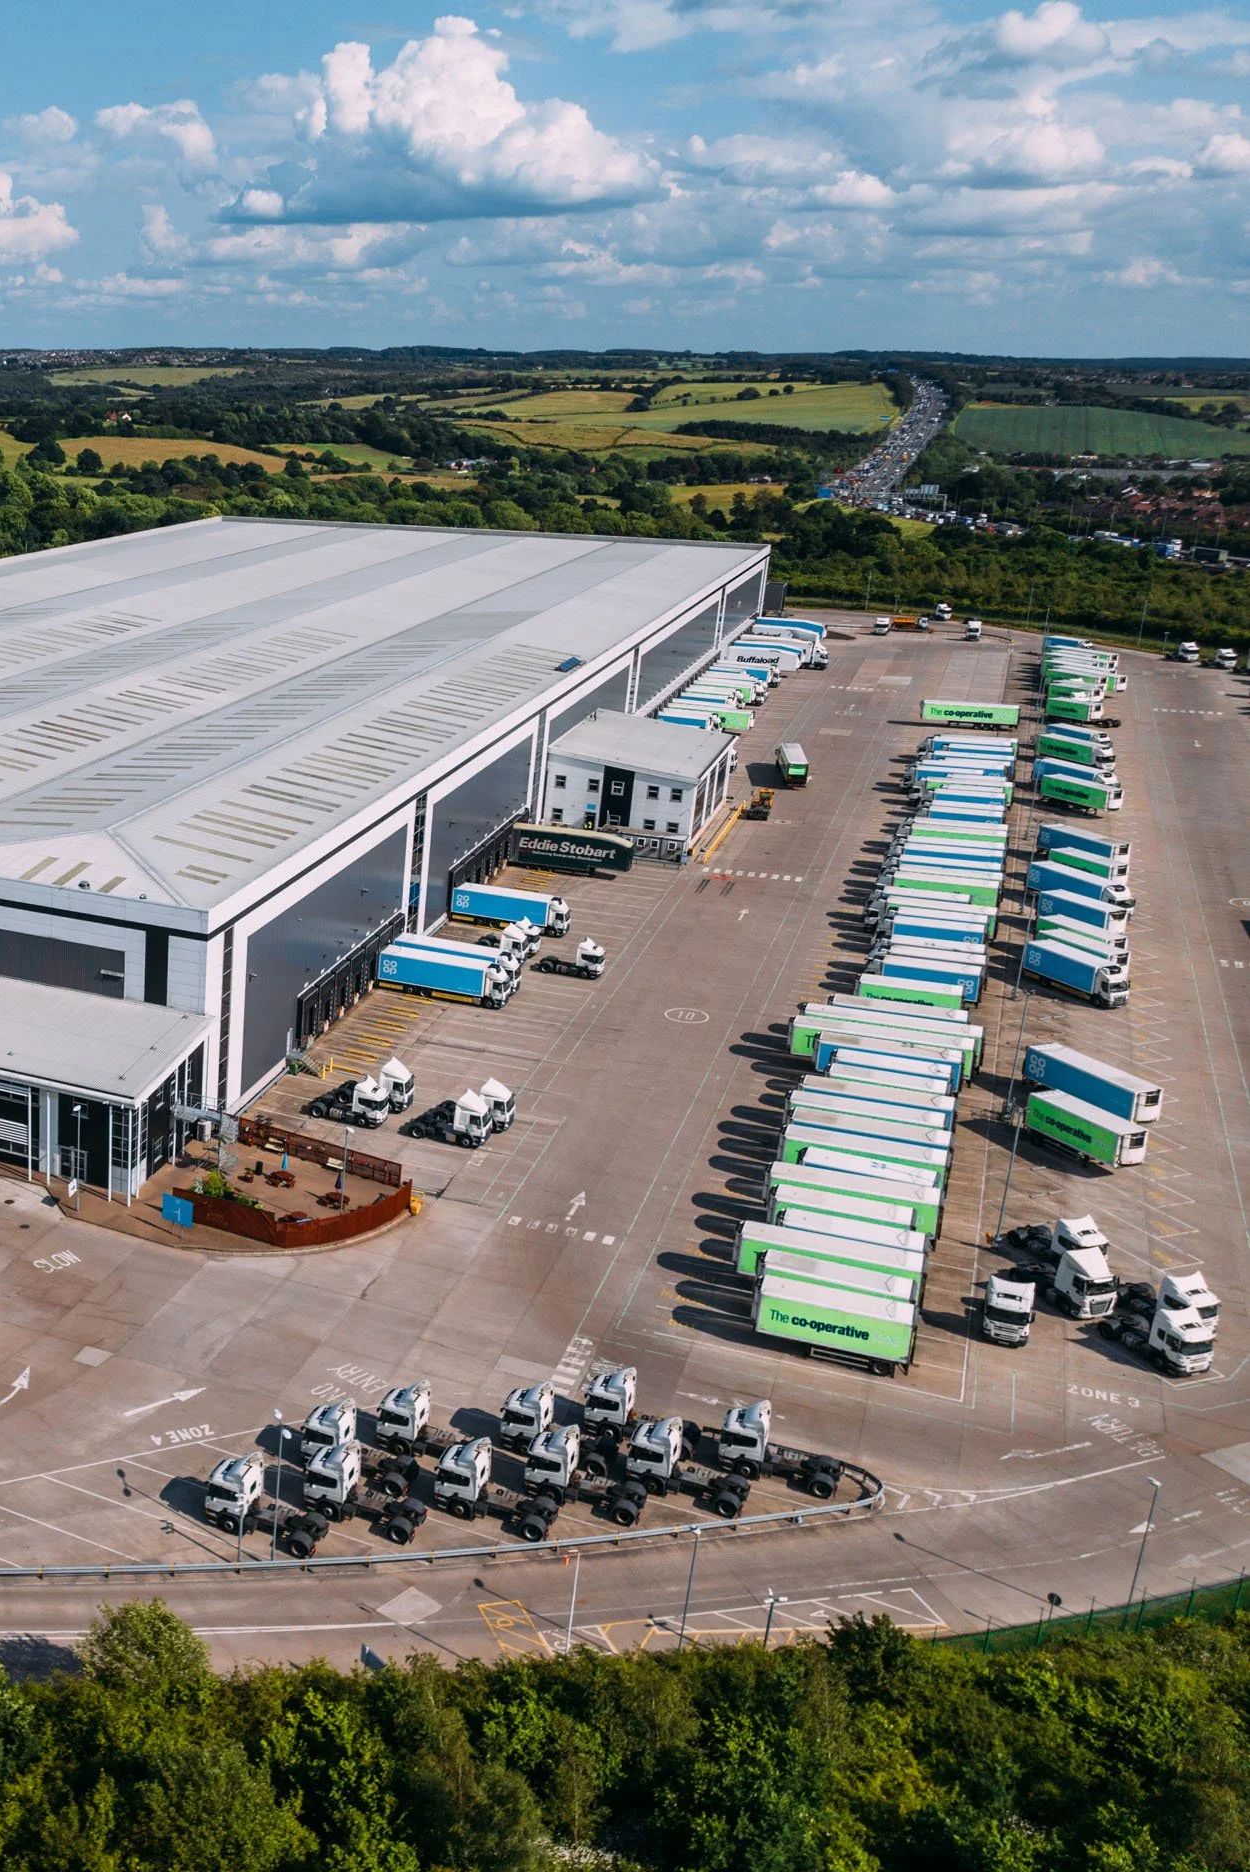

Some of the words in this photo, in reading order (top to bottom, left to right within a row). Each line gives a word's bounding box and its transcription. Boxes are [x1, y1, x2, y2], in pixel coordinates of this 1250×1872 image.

[737, 655, 780, 664] Buffaload
[931, 707, 942, 716] The
[944, 710, 993, 719] co-operative
[519, 837, 558, 852] Eddie
[559, 841, 616, 859] Stobart
[382, 966, 397, 975] op
[383, 959, 398, 968] co
[678, 1011, 695, 1020] 10
[1030, 1054, 1046, 1067] co
[1029, 1063, 1045, 1078] op
[1045, 1116, 1092, 1144] co-operative
[33, 1249, 82, 1274] SLOW
[770, 1309, 789, 1323] The
[791, 1316, 869, 1341] co-operative
[326, 1362, 390, 1394] ENTRY
[1067, 1383, 1121, 1404] ZONE
[1127, 1396, 1141, 1408] 3
[150, 1435, 162, 1446] 4
[166, 1424, 215, 1444] ZONE
